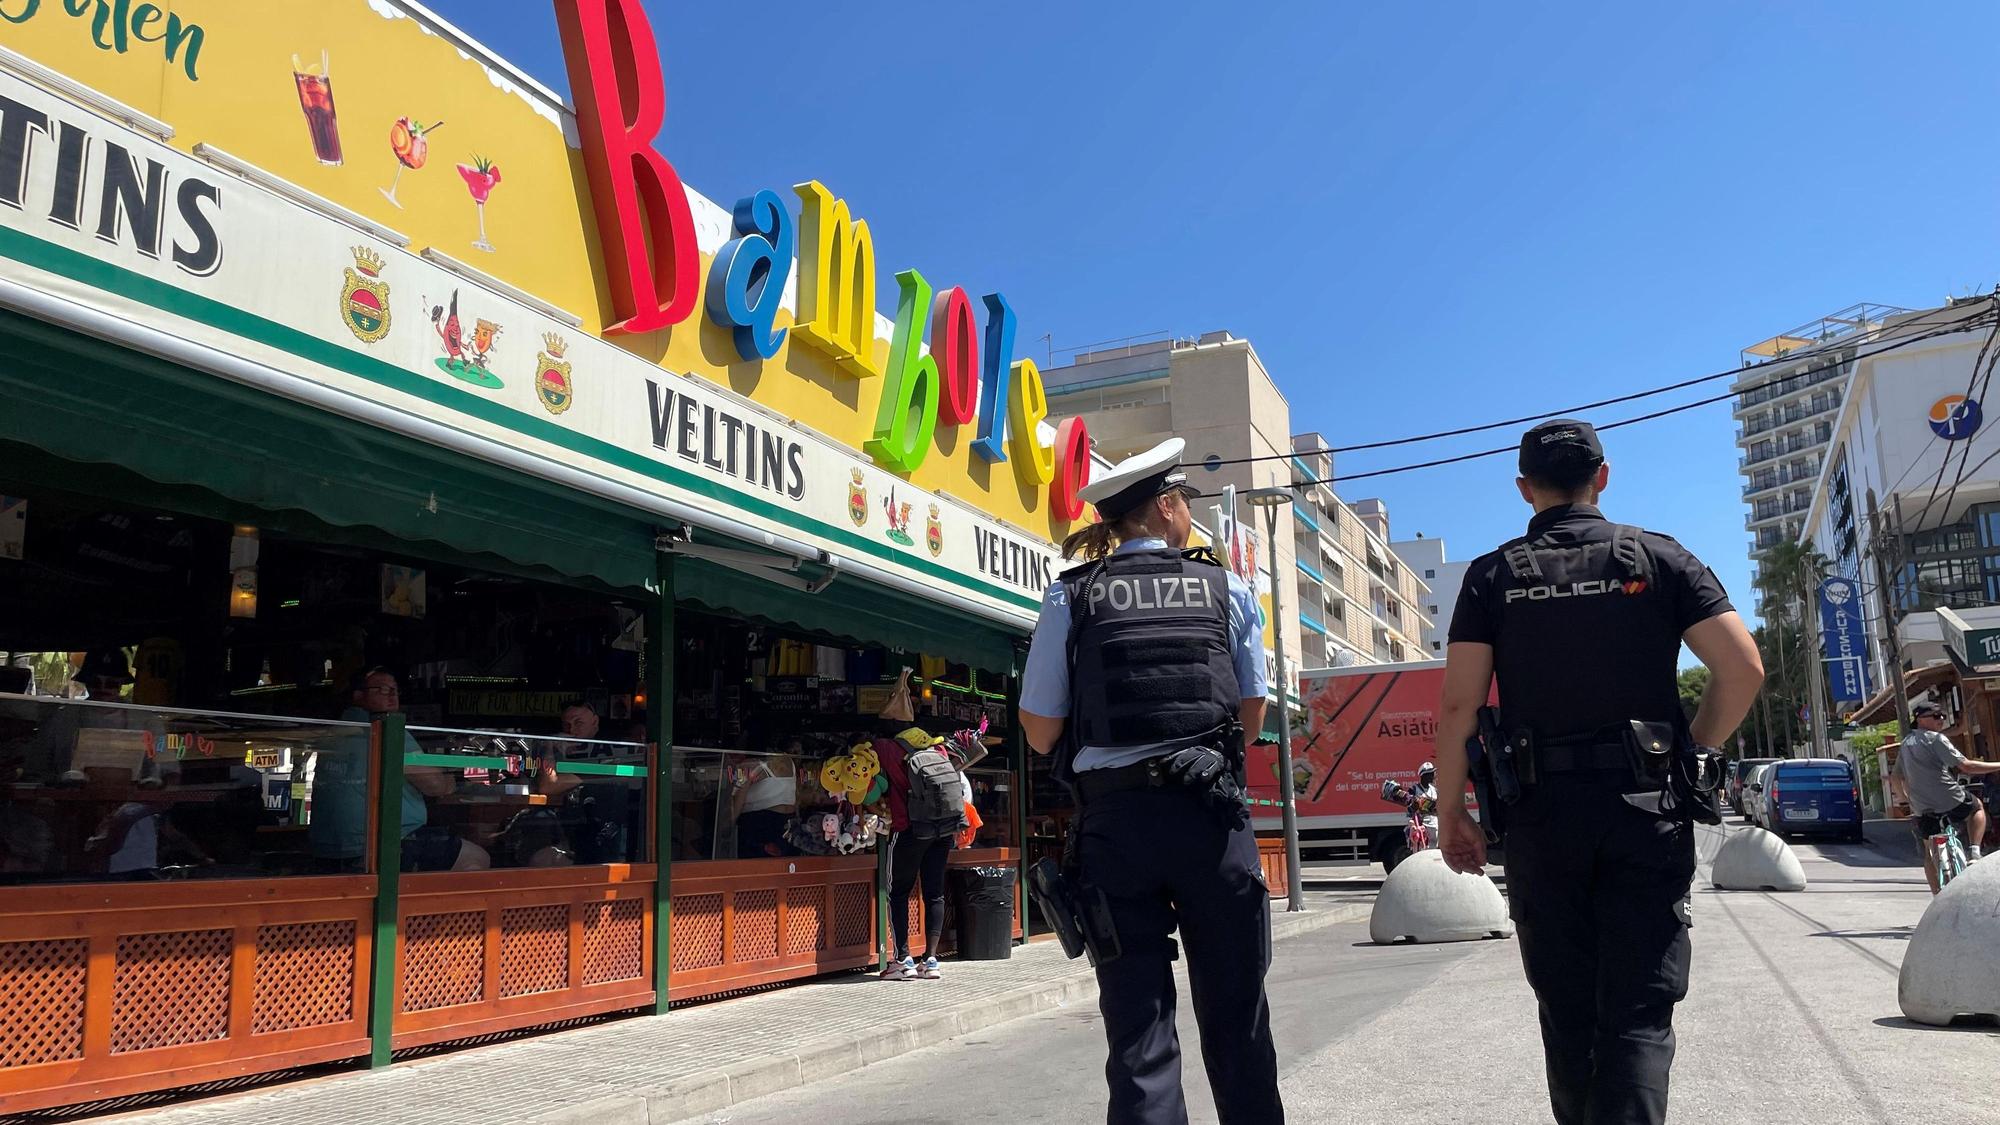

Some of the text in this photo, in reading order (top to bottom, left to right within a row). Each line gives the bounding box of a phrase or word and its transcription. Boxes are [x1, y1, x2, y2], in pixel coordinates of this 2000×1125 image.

[554, 0, 1091, 521] Bamboleo
[645, 377, 806, 502] VELTINS
[973, 524, 1051, 593] VELTINS
[1088, 576, 1213, 616] POLIZEI
[1504, 578, 1624, 604] POLICIA
[255, 755, 278, 766] ATM
